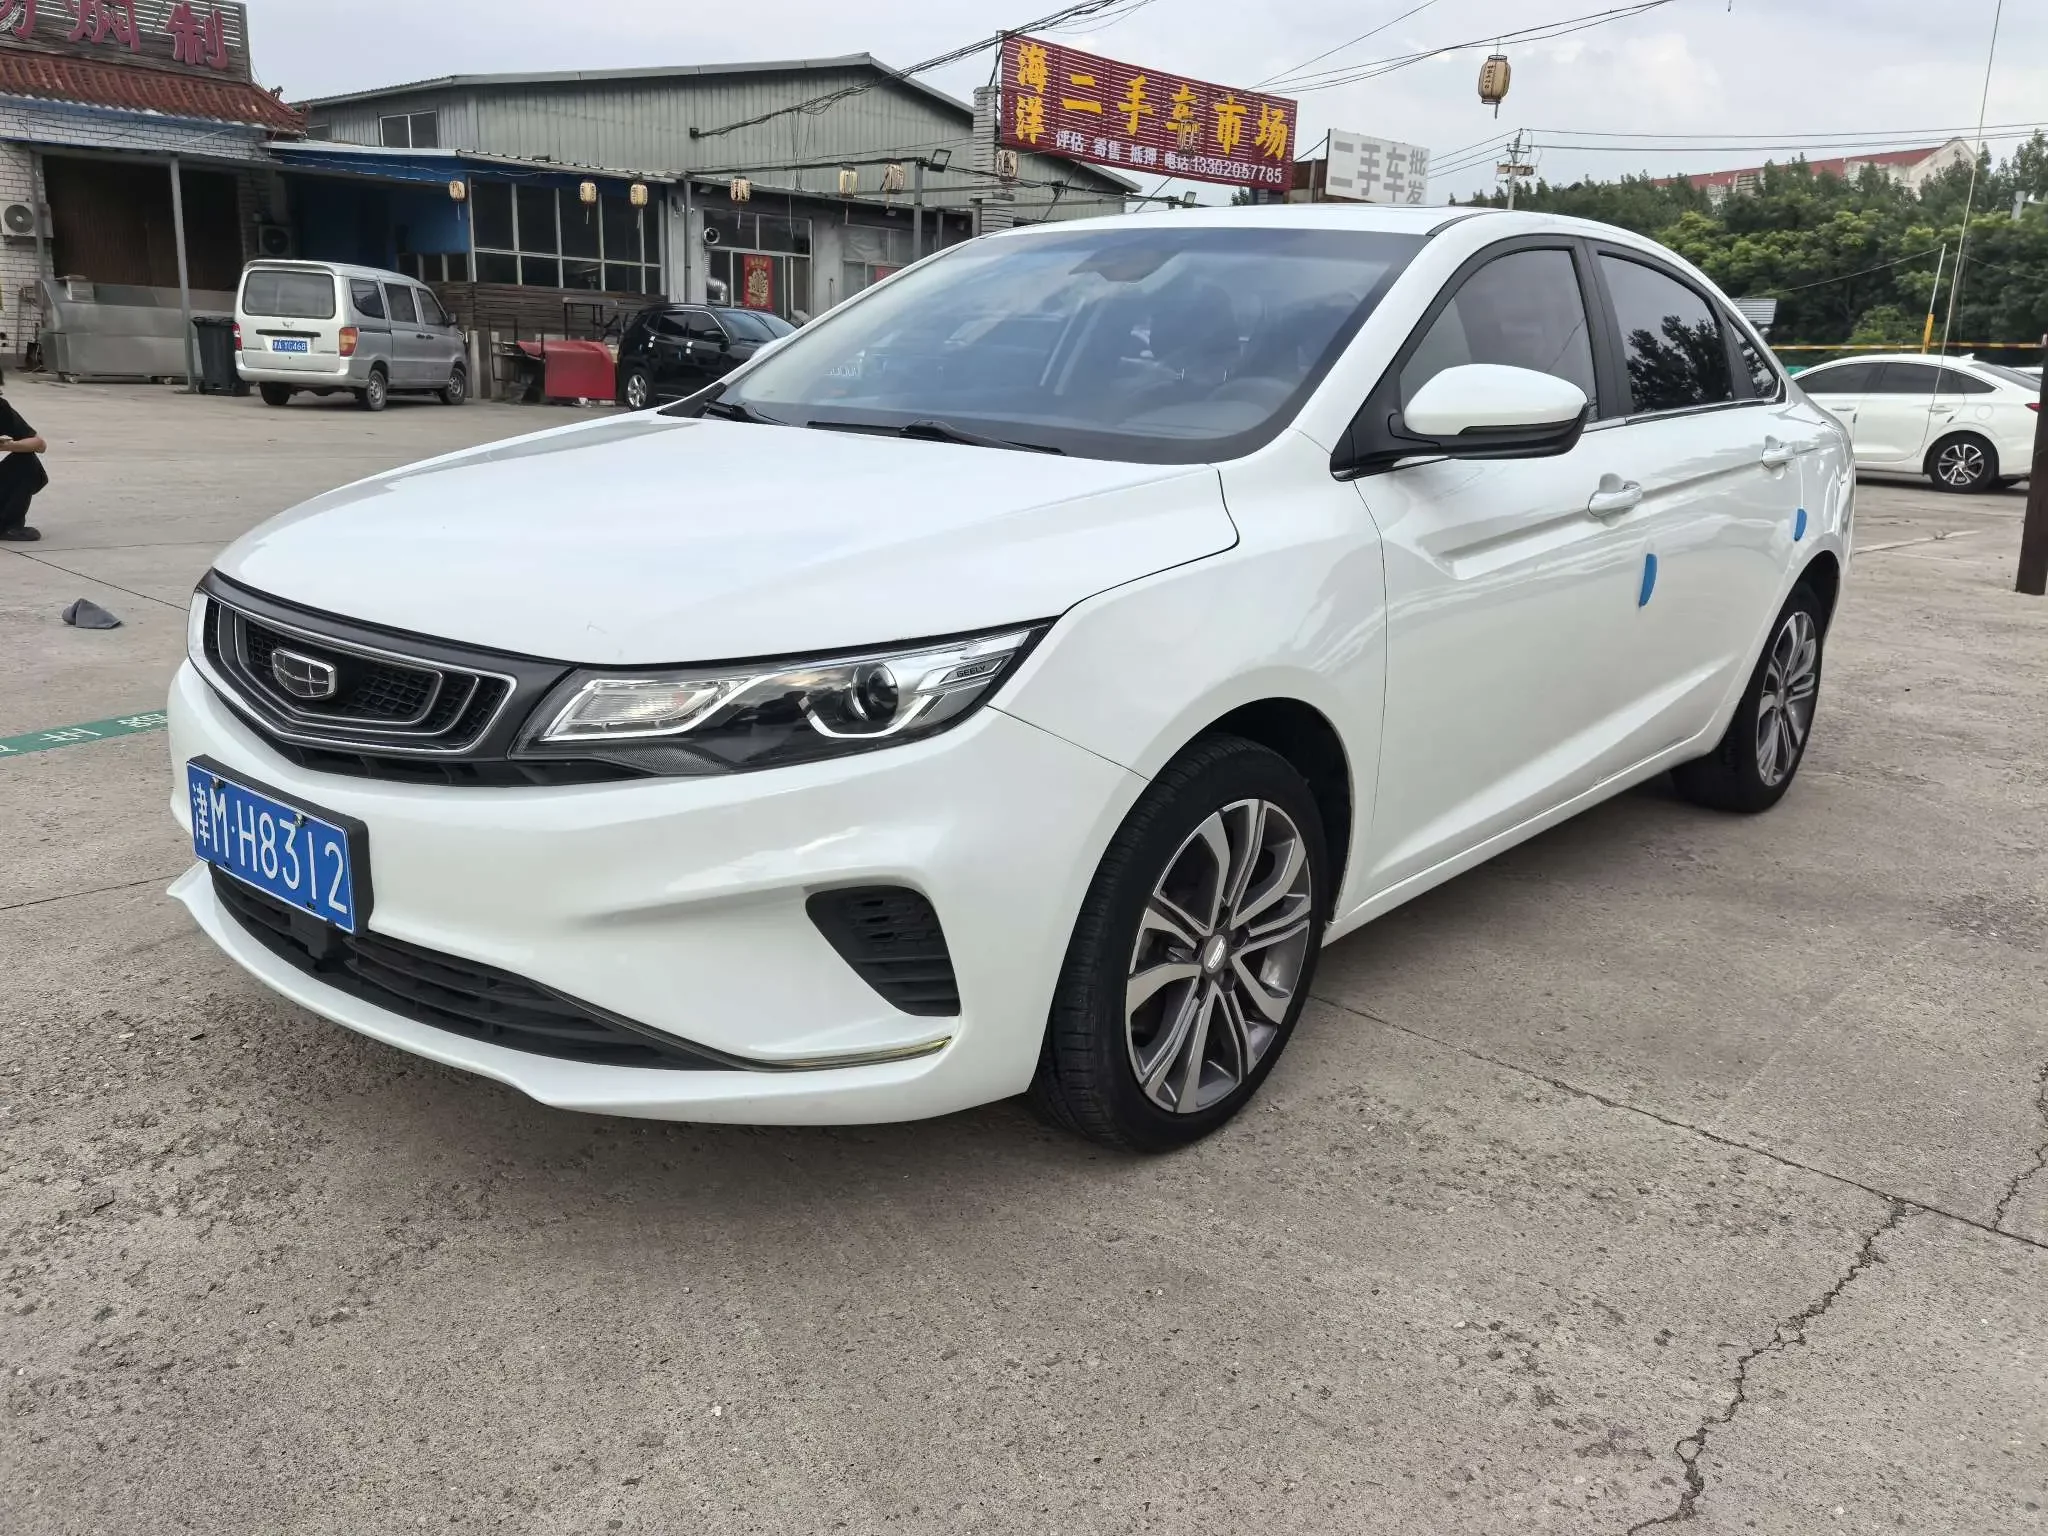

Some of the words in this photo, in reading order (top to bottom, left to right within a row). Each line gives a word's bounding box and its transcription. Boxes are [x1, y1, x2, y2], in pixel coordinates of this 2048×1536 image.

[1016, 43, 1048, 145] 海洋
[1056, 129, 1084, 152] 评估
[1093, 137, 1121, 161] 寄售
[1330, 141, 1407, 203] 二手车
[1406, 149, 1427, 204] 批发
[956, 665, 986, 678] GEELY
